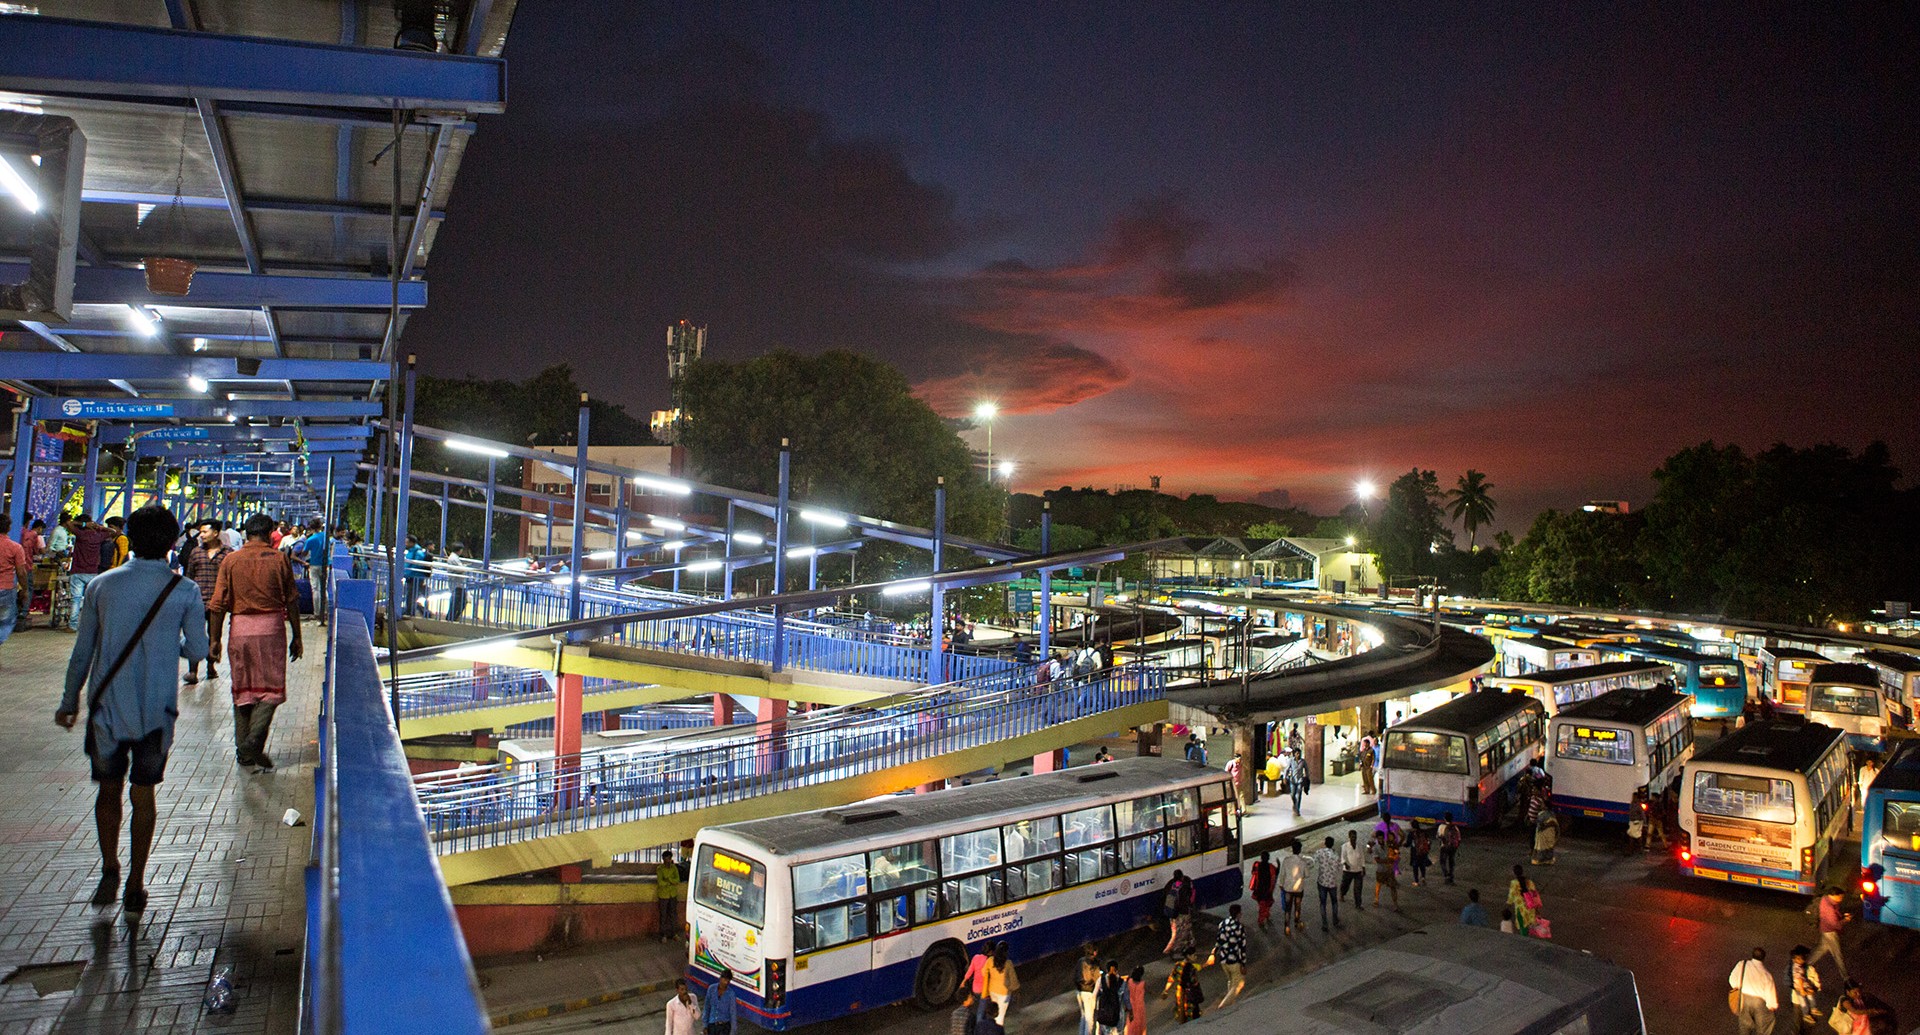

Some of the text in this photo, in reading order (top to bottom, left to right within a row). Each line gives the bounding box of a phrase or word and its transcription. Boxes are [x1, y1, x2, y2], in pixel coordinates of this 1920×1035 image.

[1705, 841, 1732, 850] GARDEN
[1733, 843, 1746, 851] CITY
[1747, 846, 1790, 857] UNIVERSITY
[716, 877, 743, 896] BMTC
[1133, 878, 1155, 889] BMTC
[972, 909, 1018, 926] BENGALURU SARIGE
